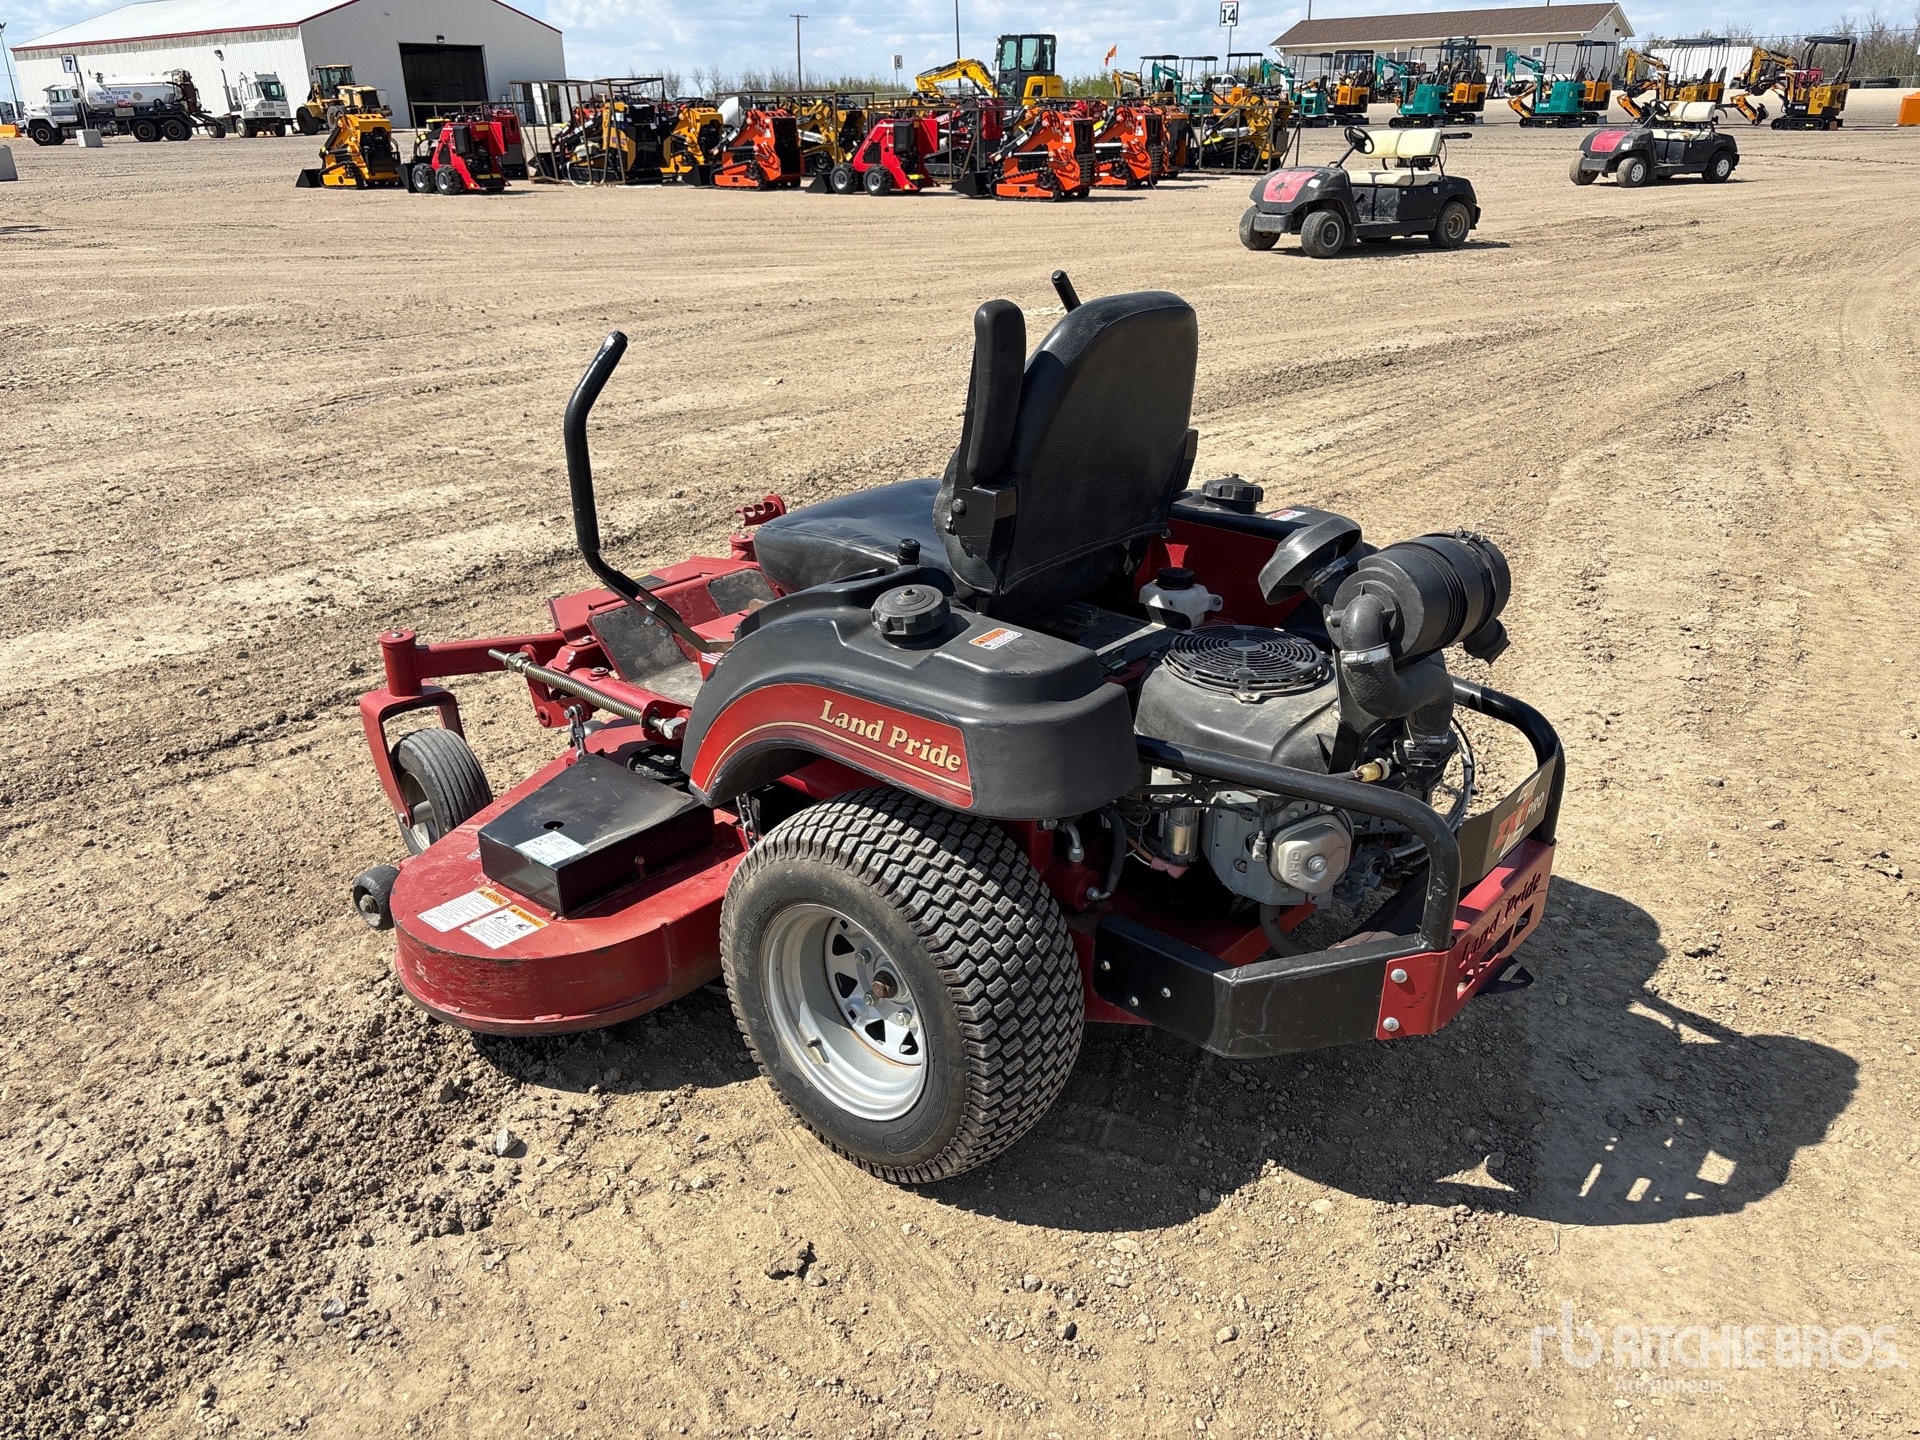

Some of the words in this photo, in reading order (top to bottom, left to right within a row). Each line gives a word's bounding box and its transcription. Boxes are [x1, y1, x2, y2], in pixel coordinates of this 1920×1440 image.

[1221, 9, 1236, 24] 14
[65, 59, 72, 71] 7
[819, 699, 885, 742] Land
[886, 724, 962, 773] Pride
[1525, 790, 1545, 822] PRO
[1289, 850, 1300, 884] OHV
[1459, 908, 1502, 968] Land
[1502, 872, 1542, 925] Pride
